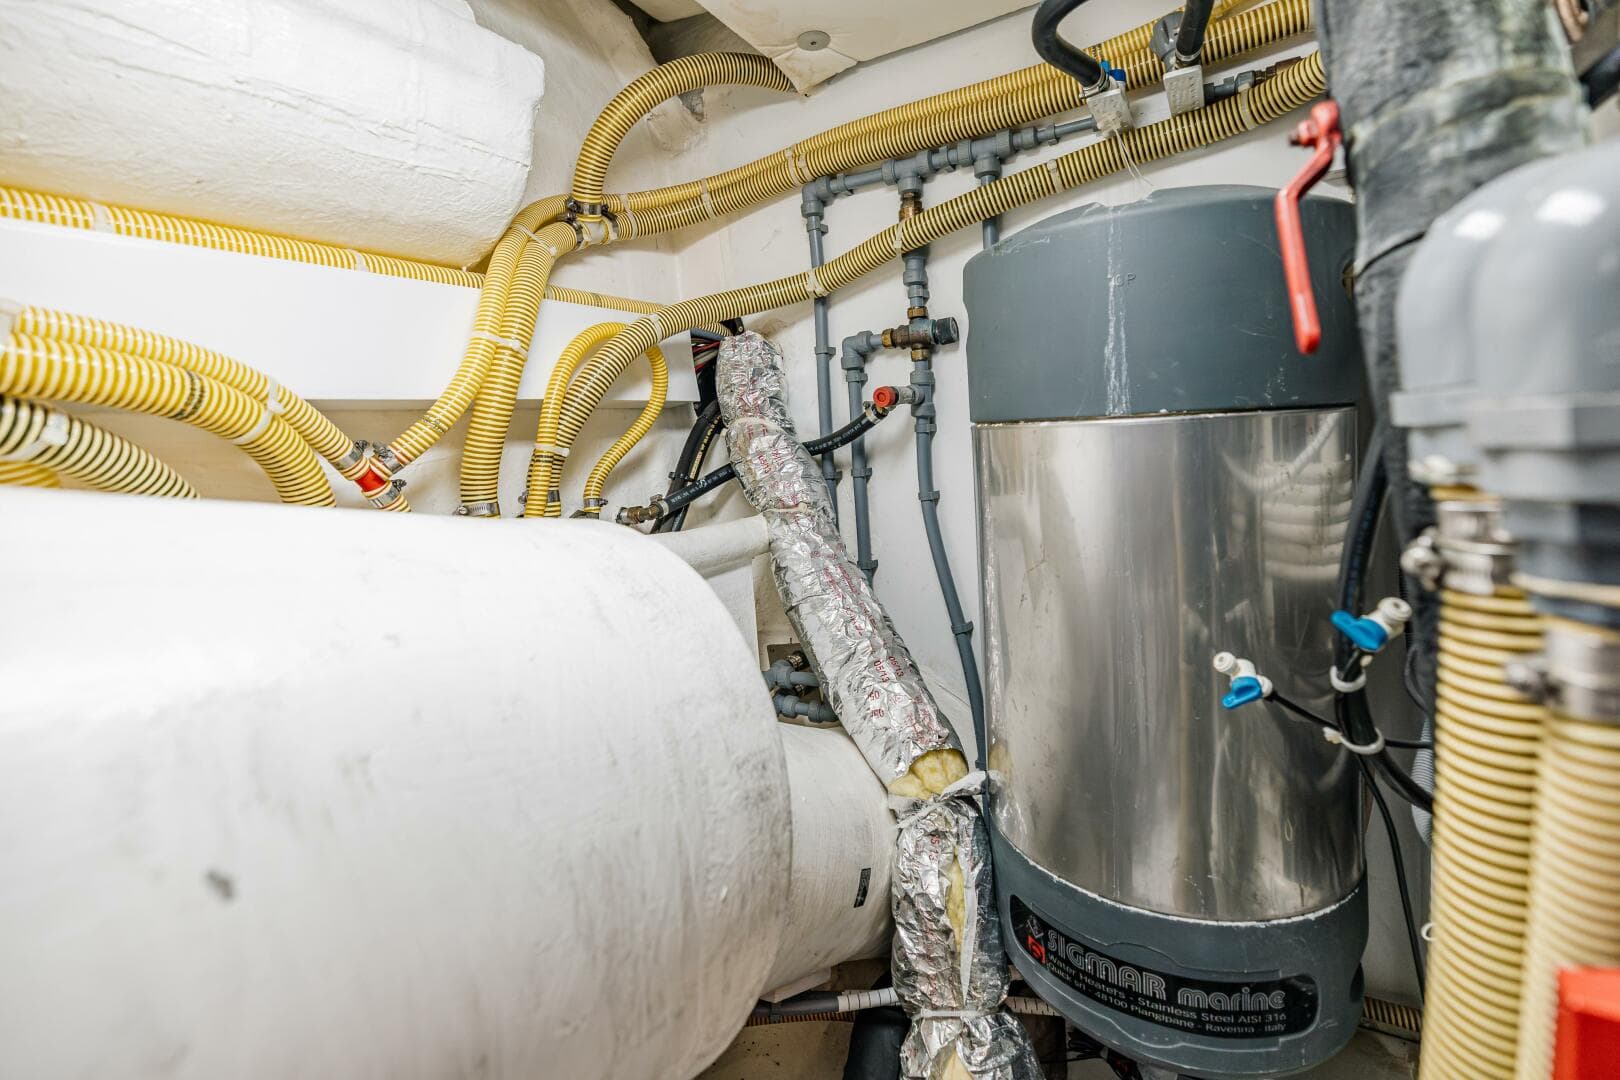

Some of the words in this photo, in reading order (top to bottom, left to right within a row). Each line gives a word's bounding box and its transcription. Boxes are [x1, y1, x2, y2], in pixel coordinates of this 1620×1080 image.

[1048, 929, 1167, 1001] SIGMAR
[1178, 987, 1286, 1011] marine
[1048, 953, 1075, 977] Water
[1080, 973, 1126, 999] Heaters
[1138, 997, 1197, 1019] Stainless
[1201, 1013, 1234, 1023] Steel
[1238, 1015, 1261, 1024] AISI
[1265, 1013, 1287, 1022] 316
[1048, 962, 1072, 981] Quick
[1095, 991, 1128, 1009] 48100
[1206, 1023, 1255, 1033] Ravenna
